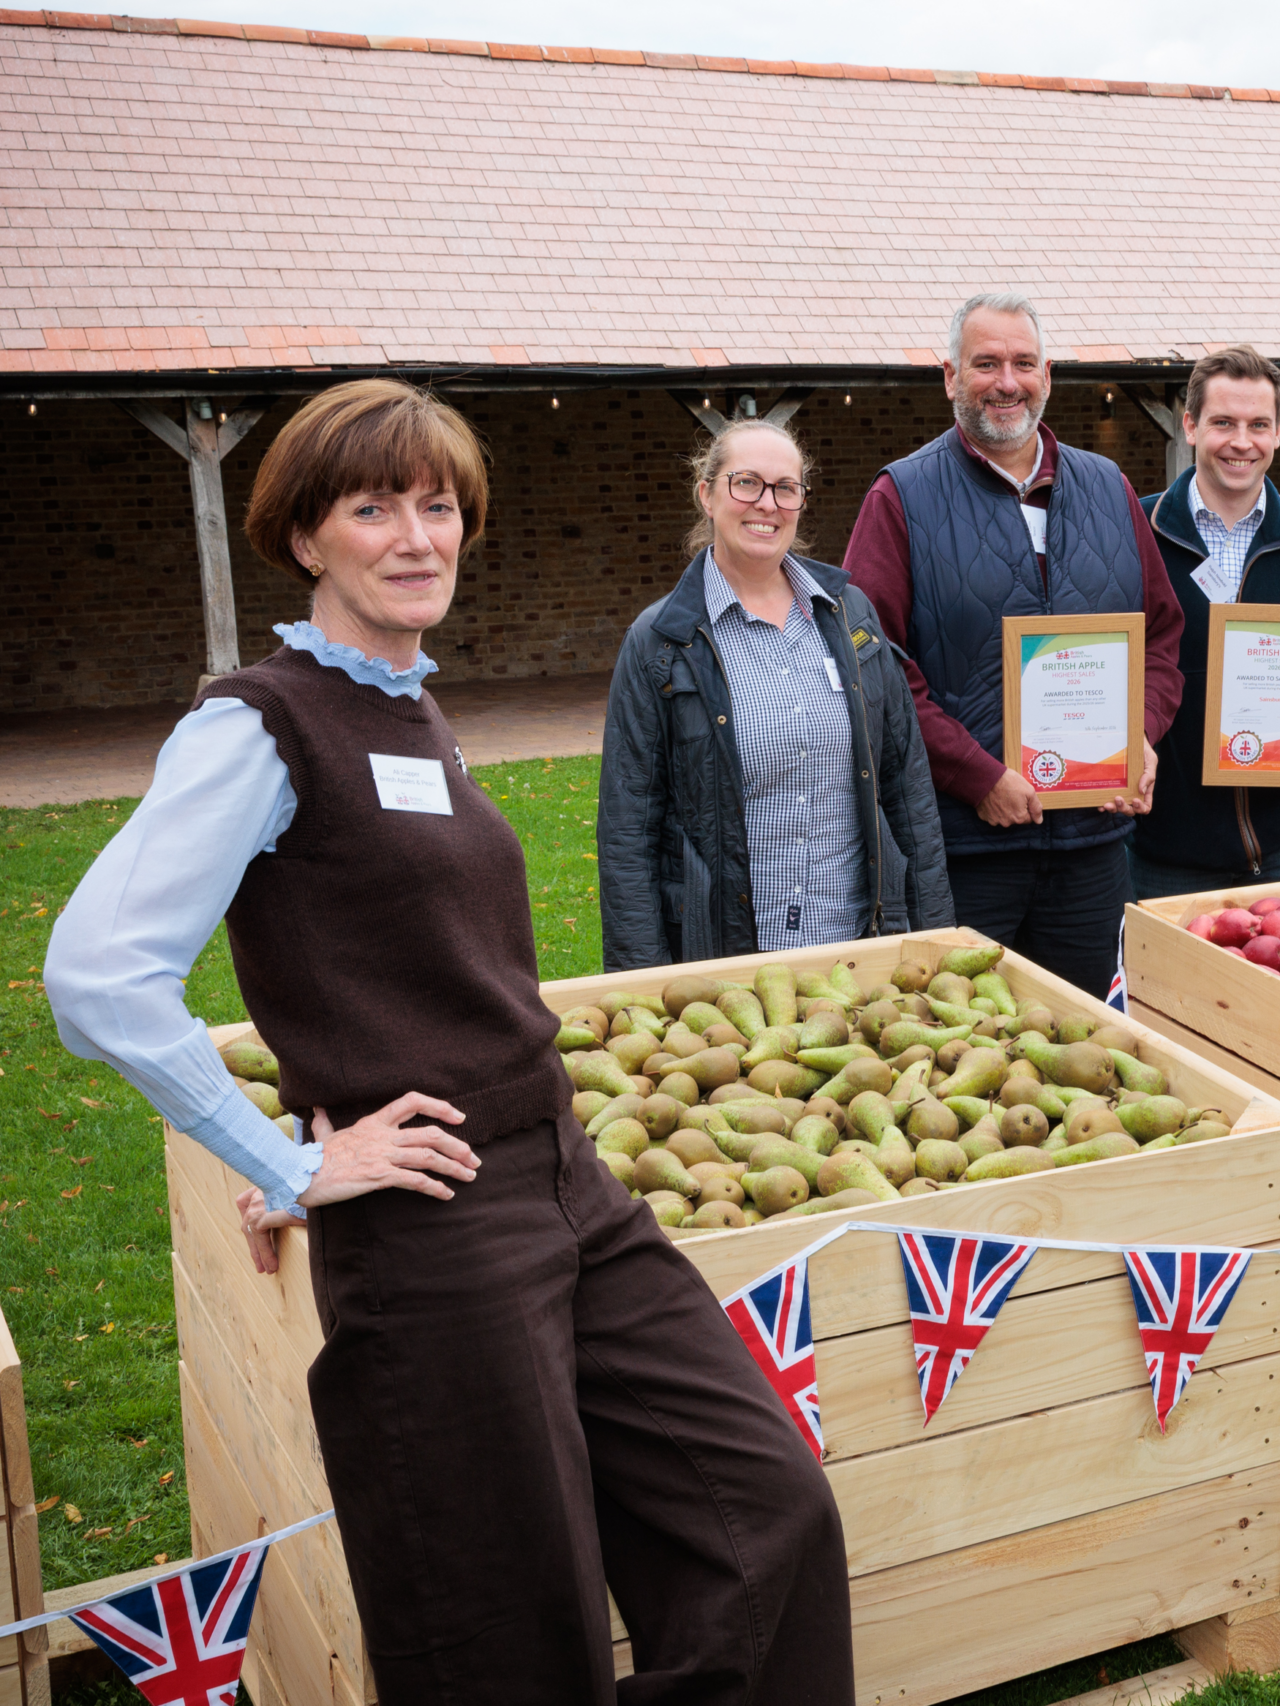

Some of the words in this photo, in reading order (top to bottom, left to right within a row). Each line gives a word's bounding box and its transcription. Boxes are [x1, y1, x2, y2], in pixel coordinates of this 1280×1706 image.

[1247, 648, 1280, 656] BRITISH
[1042, 662, 1075, 671] BRITISH
[1078, 661, 1105, 669] APPLE
